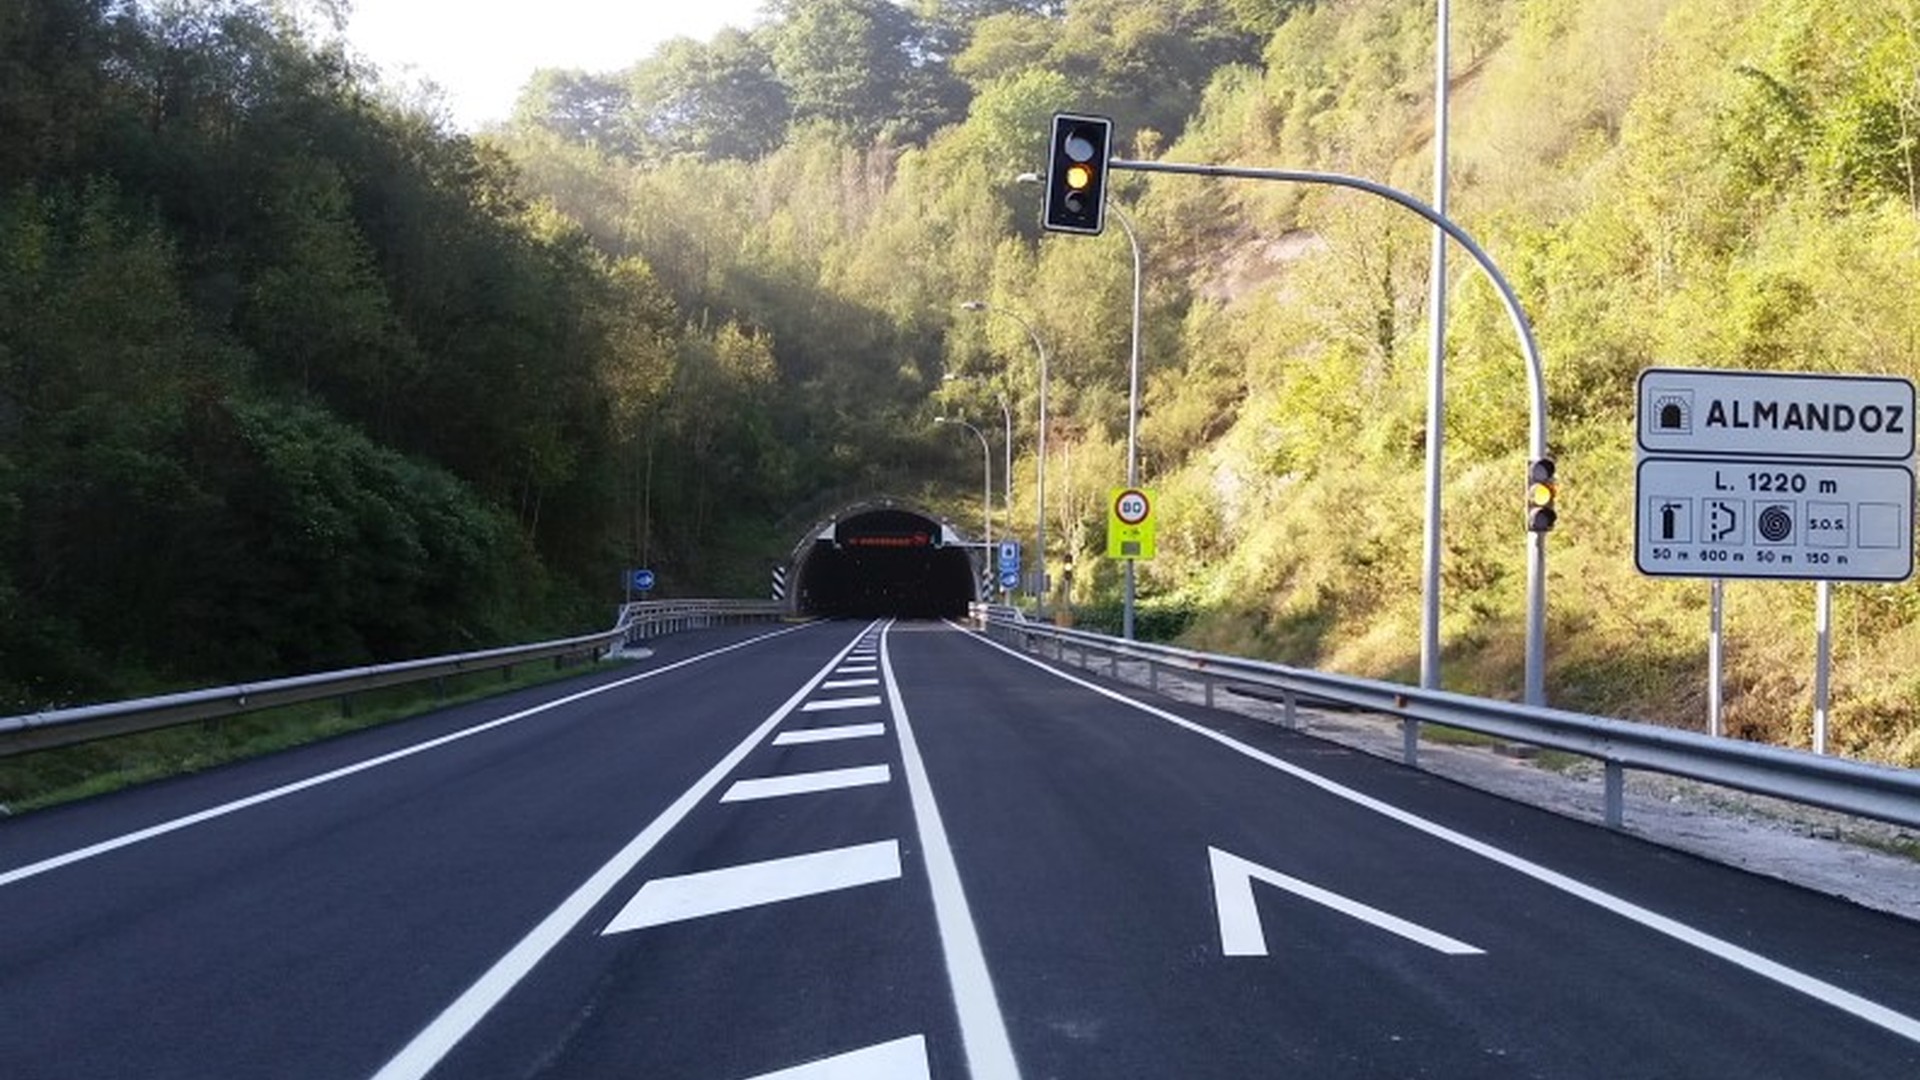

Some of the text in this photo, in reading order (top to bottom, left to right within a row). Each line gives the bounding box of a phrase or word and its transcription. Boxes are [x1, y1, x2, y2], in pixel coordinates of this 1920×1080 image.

[1705, 399, 1904, 434] ALMANDOZ
[1714, 470, 1838, 494] L. 1220 m
[1122, 501, 1143, 514] 80
[1652, 547, 1689, 561] 50 m
[1699, 549, 1745, 562] 600 m
[1756, 550, 1793, 564] 50 m
[1805, 552, 1849, 565] 150 m
